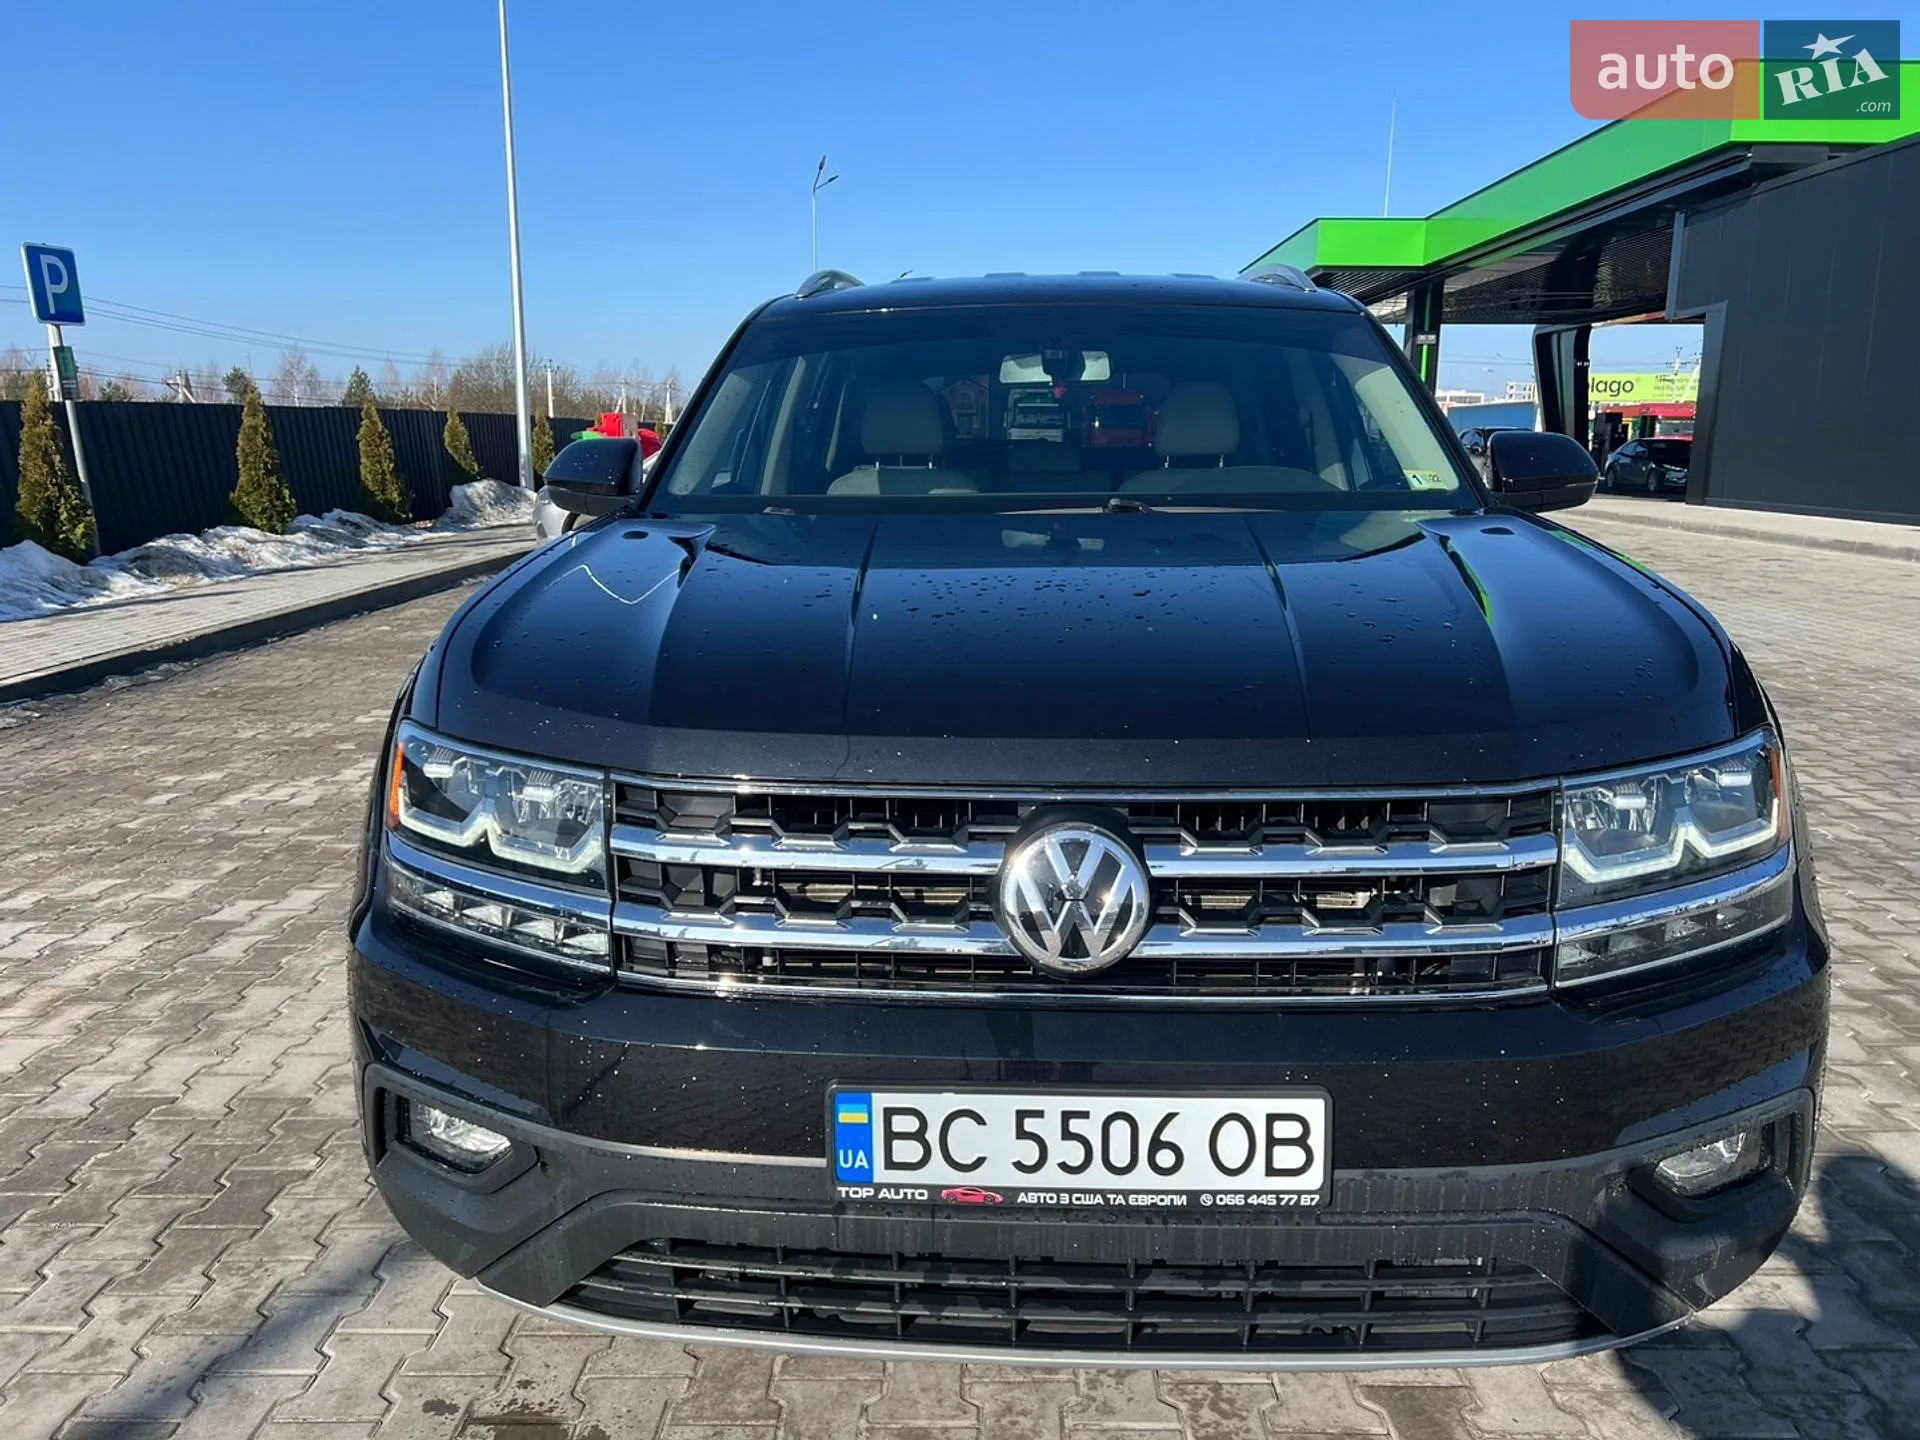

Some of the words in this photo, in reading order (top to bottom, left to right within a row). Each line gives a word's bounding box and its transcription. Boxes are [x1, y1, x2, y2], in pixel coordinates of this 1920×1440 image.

[39, 253, 69, 315] P
[1588, 376, 1635, 397] lago
[882, 1106, 988, 1173] BC
[1010, 1108, 1185, 1176] 5506
[1208, 1111, 1315, 1177] OB
[838, 1149, 869, 1169] UA
[837, 1186, 875, 1199] TOP
[877, 1187, 928, 1200] AUTO
[1016, 1192, 1057, 1205] АВТО
[1071, 1193, 1105, 1206] США
[1106, 1194, 1127, 1206] ТА
[1128, 1194, 1187, 1206] ЄВРОПИ
[1215, 1194, 1245, 1206] 066
[1247, 1194, 1277, 1206] 445
[1279, 1194, 1298, 1206] 77
[1299, 1194, 1320, 1206] 87
